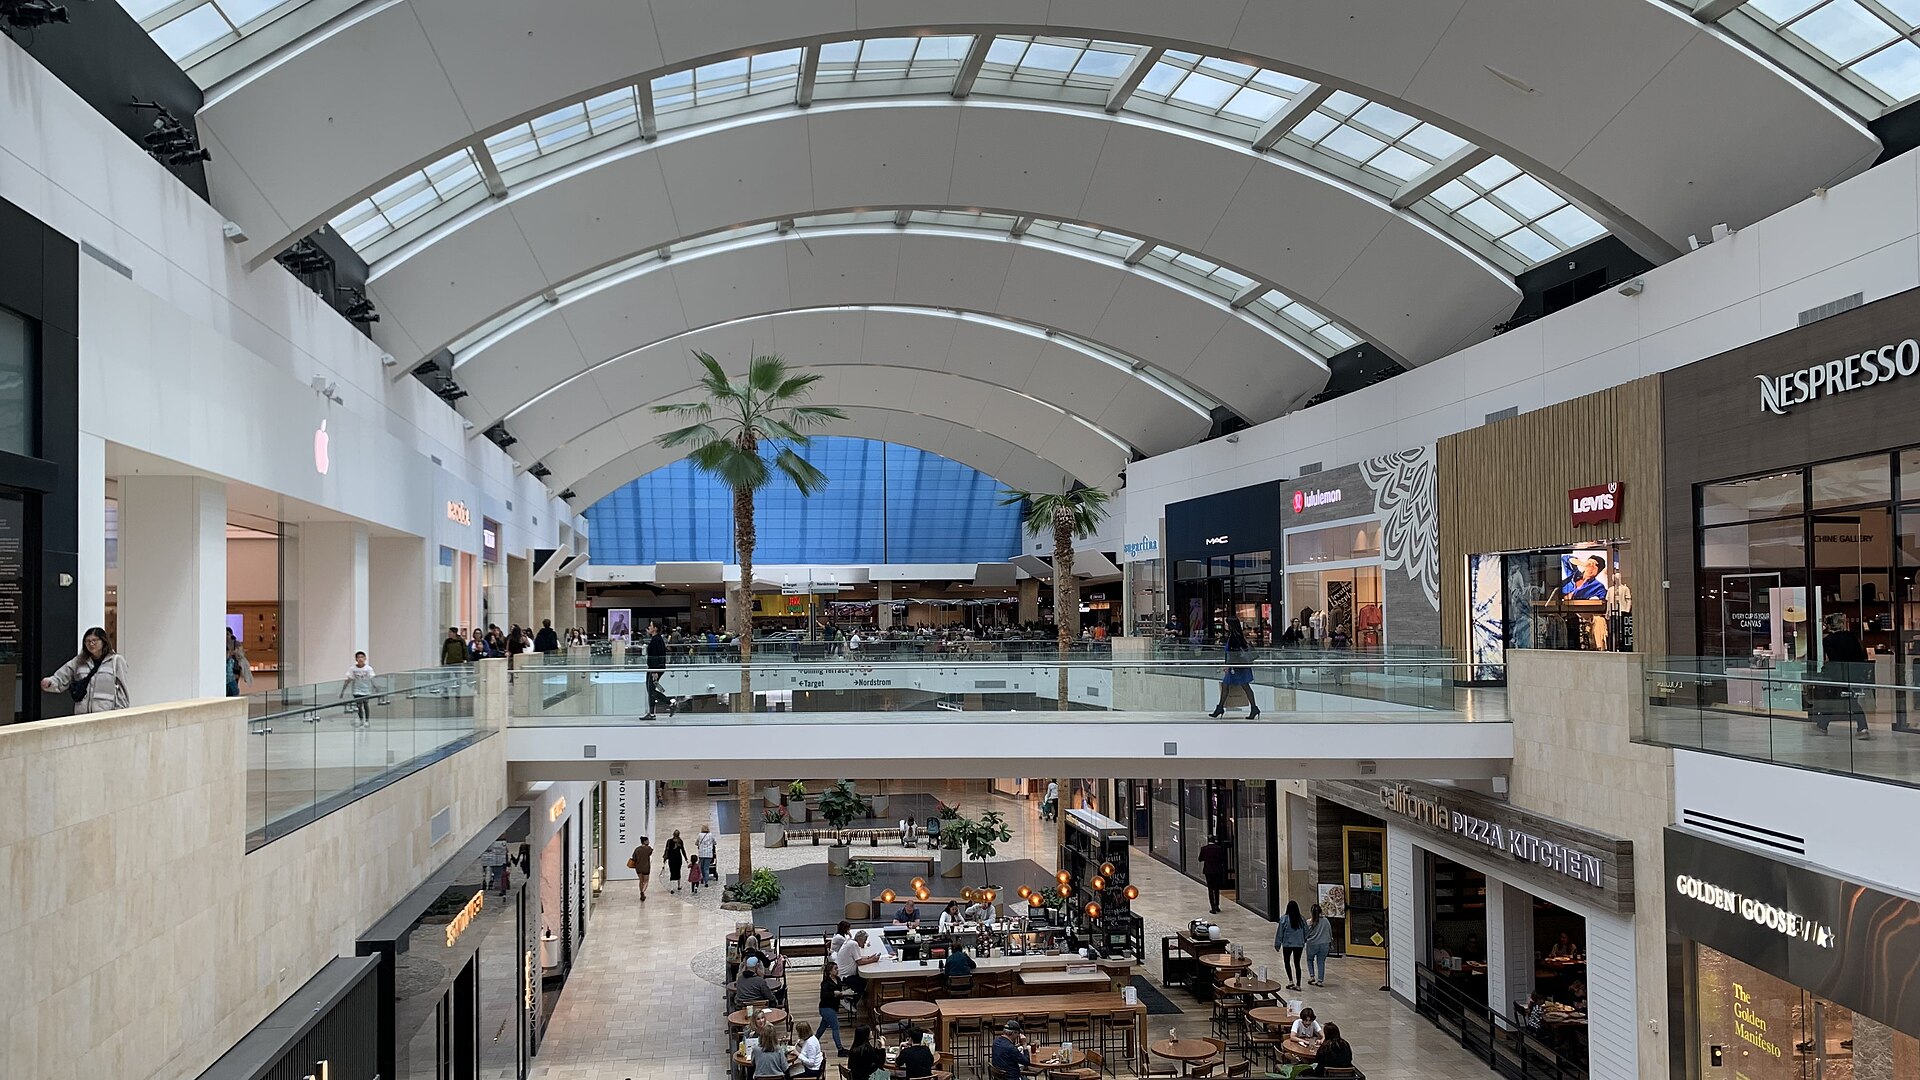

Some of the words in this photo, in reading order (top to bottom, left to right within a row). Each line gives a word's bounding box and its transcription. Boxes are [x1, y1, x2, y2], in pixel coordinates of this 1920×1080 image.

[1754, 339, 1919, 415] NESPRESSO
[1304, 488, 1341, 508] lululemon
[1124, 535, 1157, 557] sugarfina
[1839, 535, 1873, 543] GALLERY
[804, 680, 825, 688] Target
[858, 678, 892, 687] Nordstrom
[1452, 811, 1506, 850] PIZZA
[1508, 828, 1603, 888] KITCHEN
[1676, 874, 1736, 914] GOLDEN
[1741, 898, 1798, 937] GOOSE
[1732, 982, 1751, 1004] The
[1734, 1002, 1767, 1032] Golden
[1734, 1020, 1781, 1058] Manifesto
